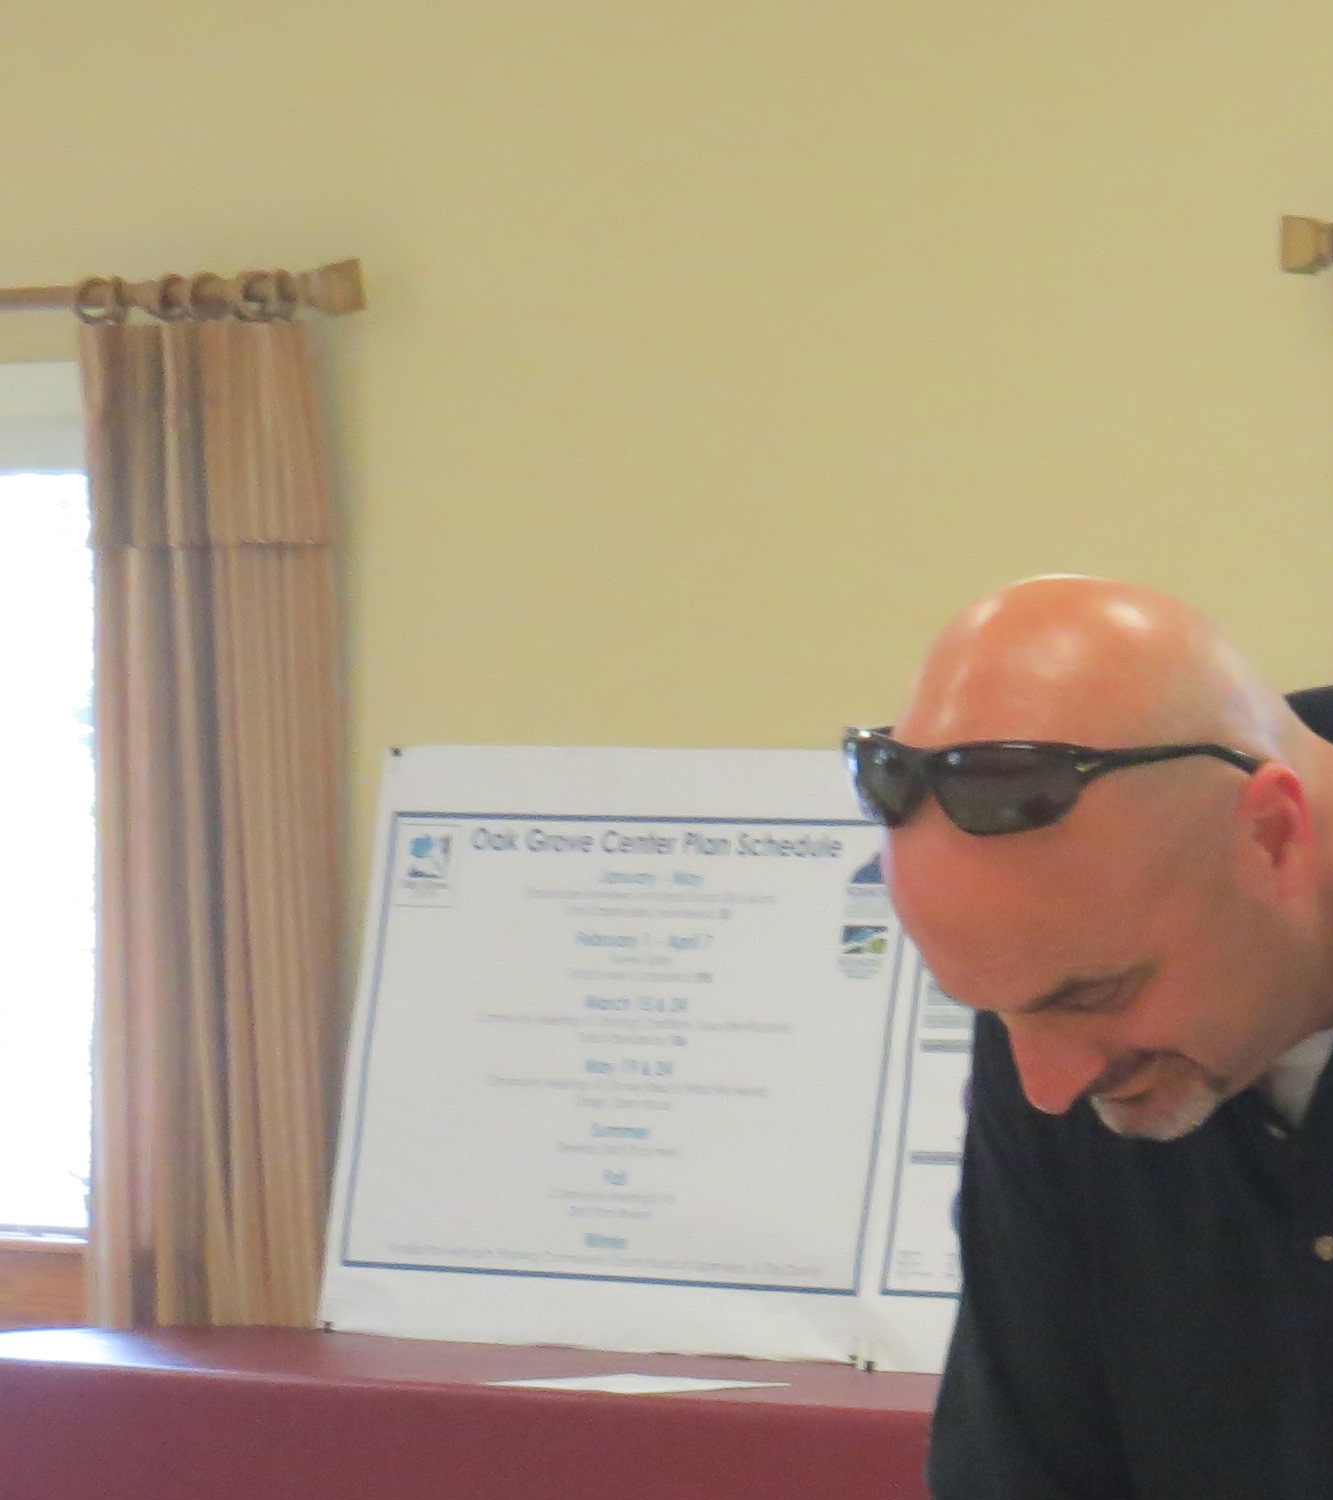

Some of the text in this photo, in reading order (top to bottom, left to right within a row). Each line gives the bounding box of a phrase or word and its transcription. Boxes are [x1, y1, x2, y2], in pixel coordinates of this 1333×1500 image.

[471, 827, 843, 858] Oak Grove Center Plan Schedule
